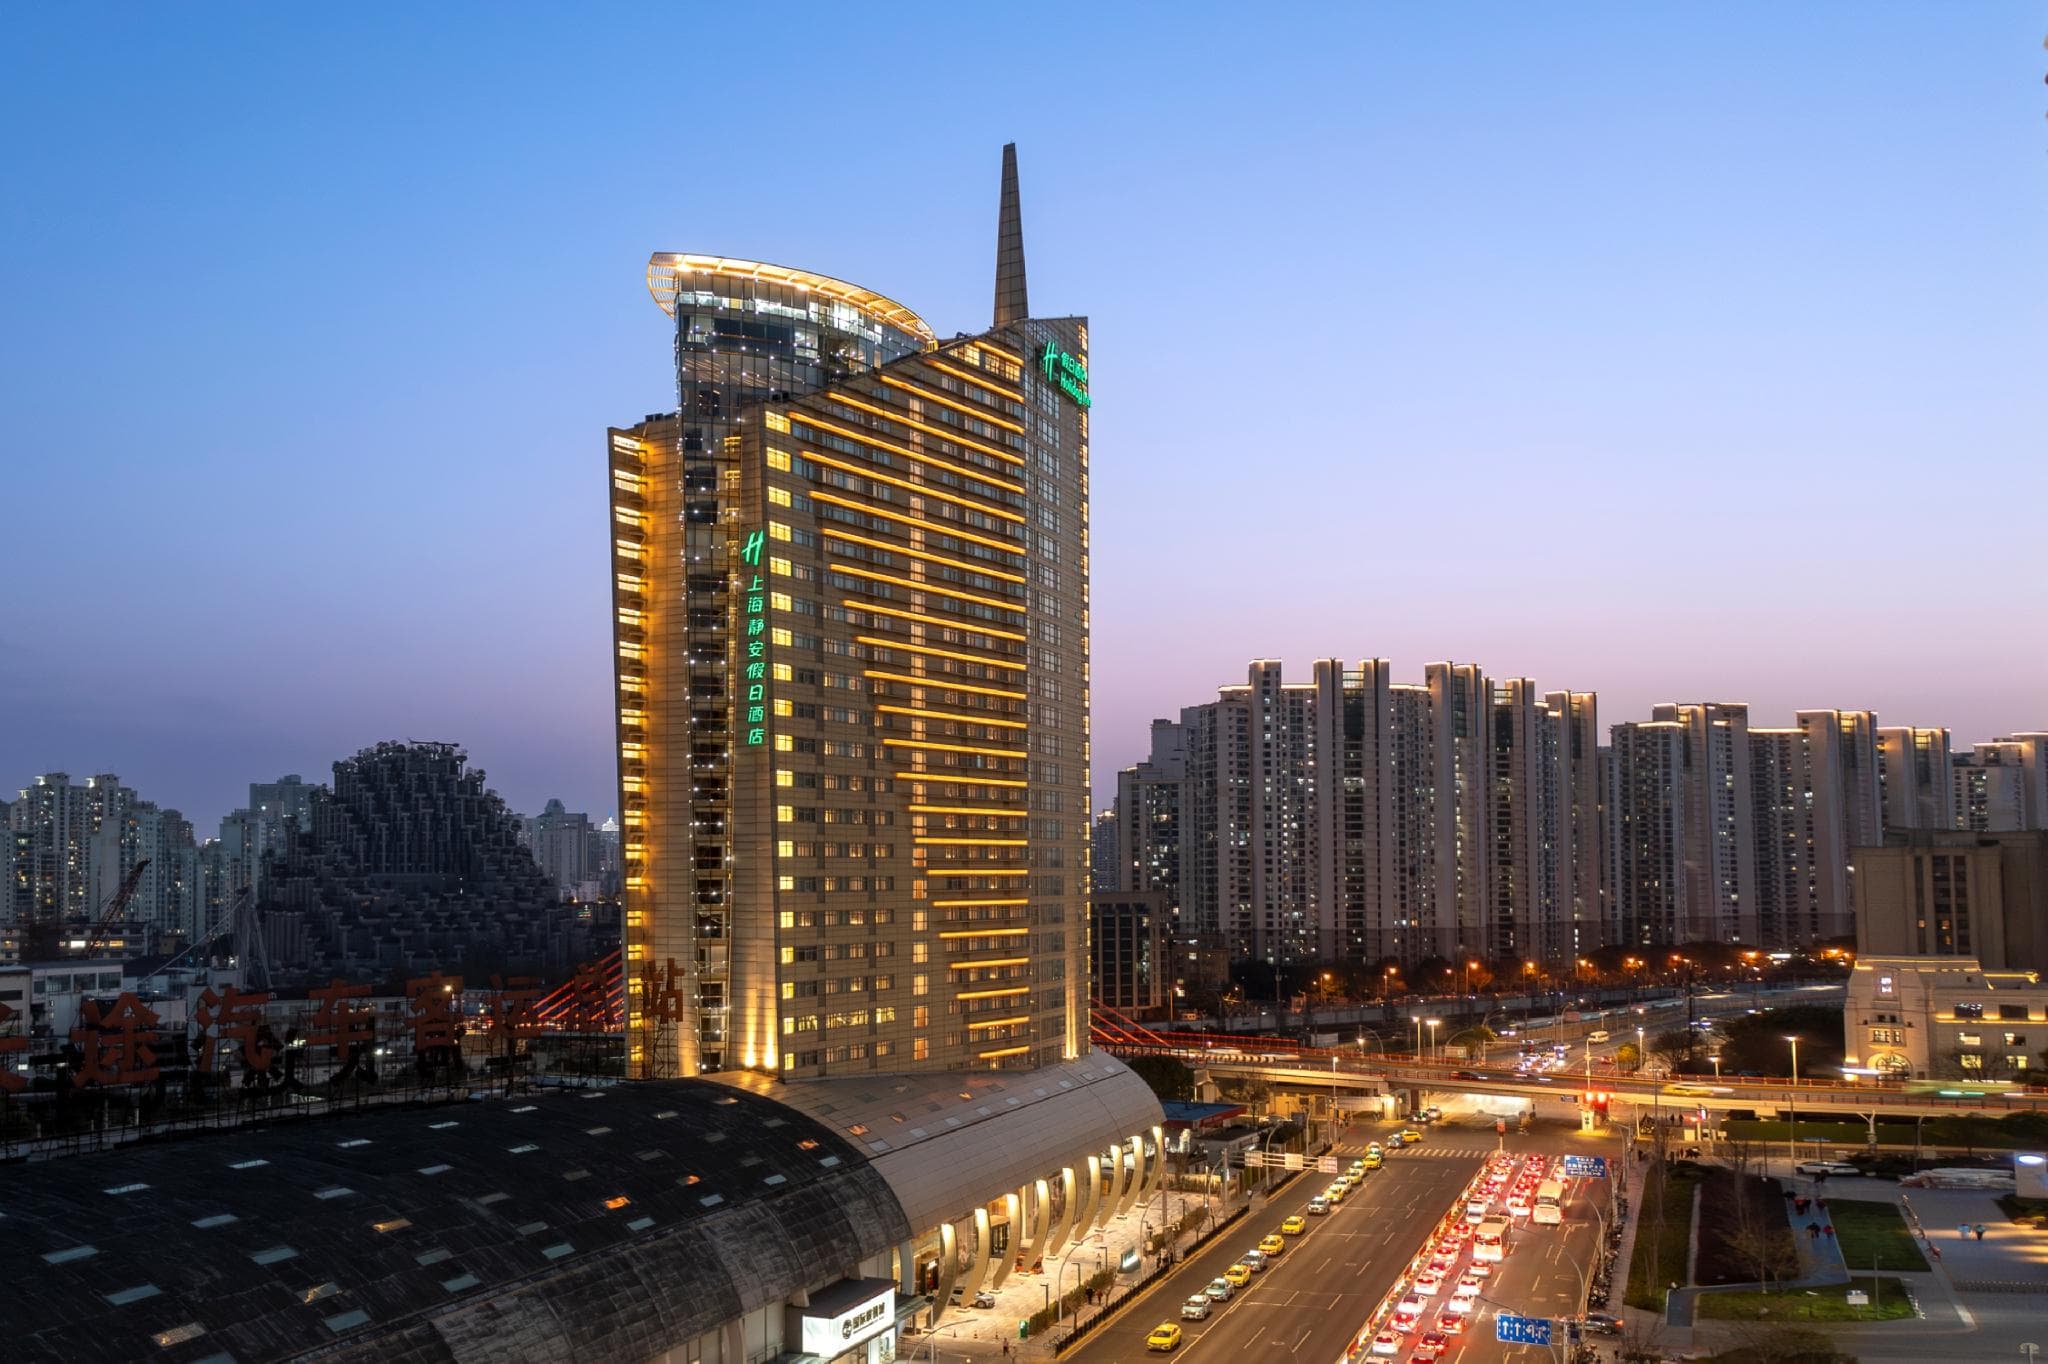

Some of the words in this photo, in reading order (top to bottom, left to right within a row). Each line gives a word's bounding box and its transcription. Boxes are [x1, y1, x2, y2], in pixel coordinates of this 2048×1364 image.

[747, 574, 766, 745] 上海静安假日酒店
